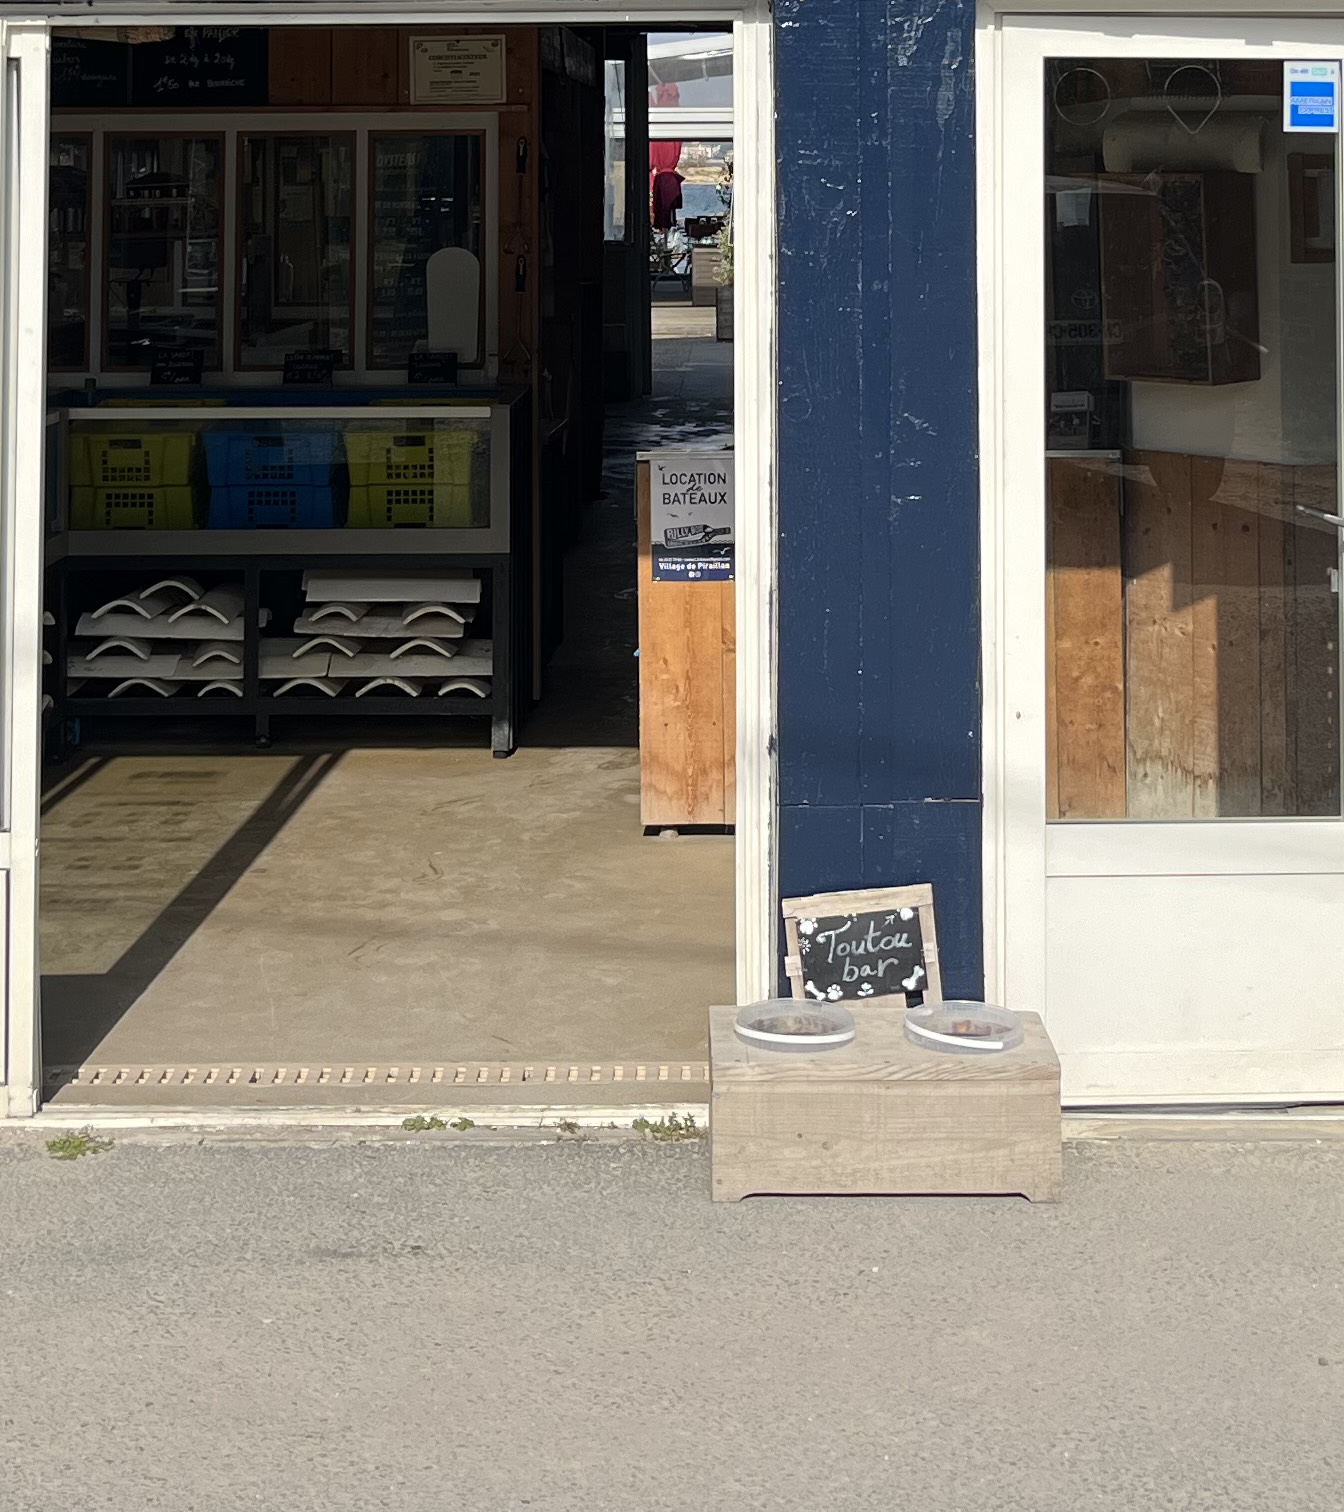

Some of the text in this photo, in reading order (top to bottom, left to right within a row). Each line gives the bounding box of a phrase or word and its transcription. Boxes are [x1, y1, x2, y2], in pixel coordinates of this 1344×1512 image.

[662, 472, 727, 486] LOCATION
[686, 482, 703, 494] de
[662, 492, 727, 506] BATEAUX
[658, 563, 685, 571] Village
[816, 920, 913, 964] Toutou
[843, 956, 899, 981] bar
